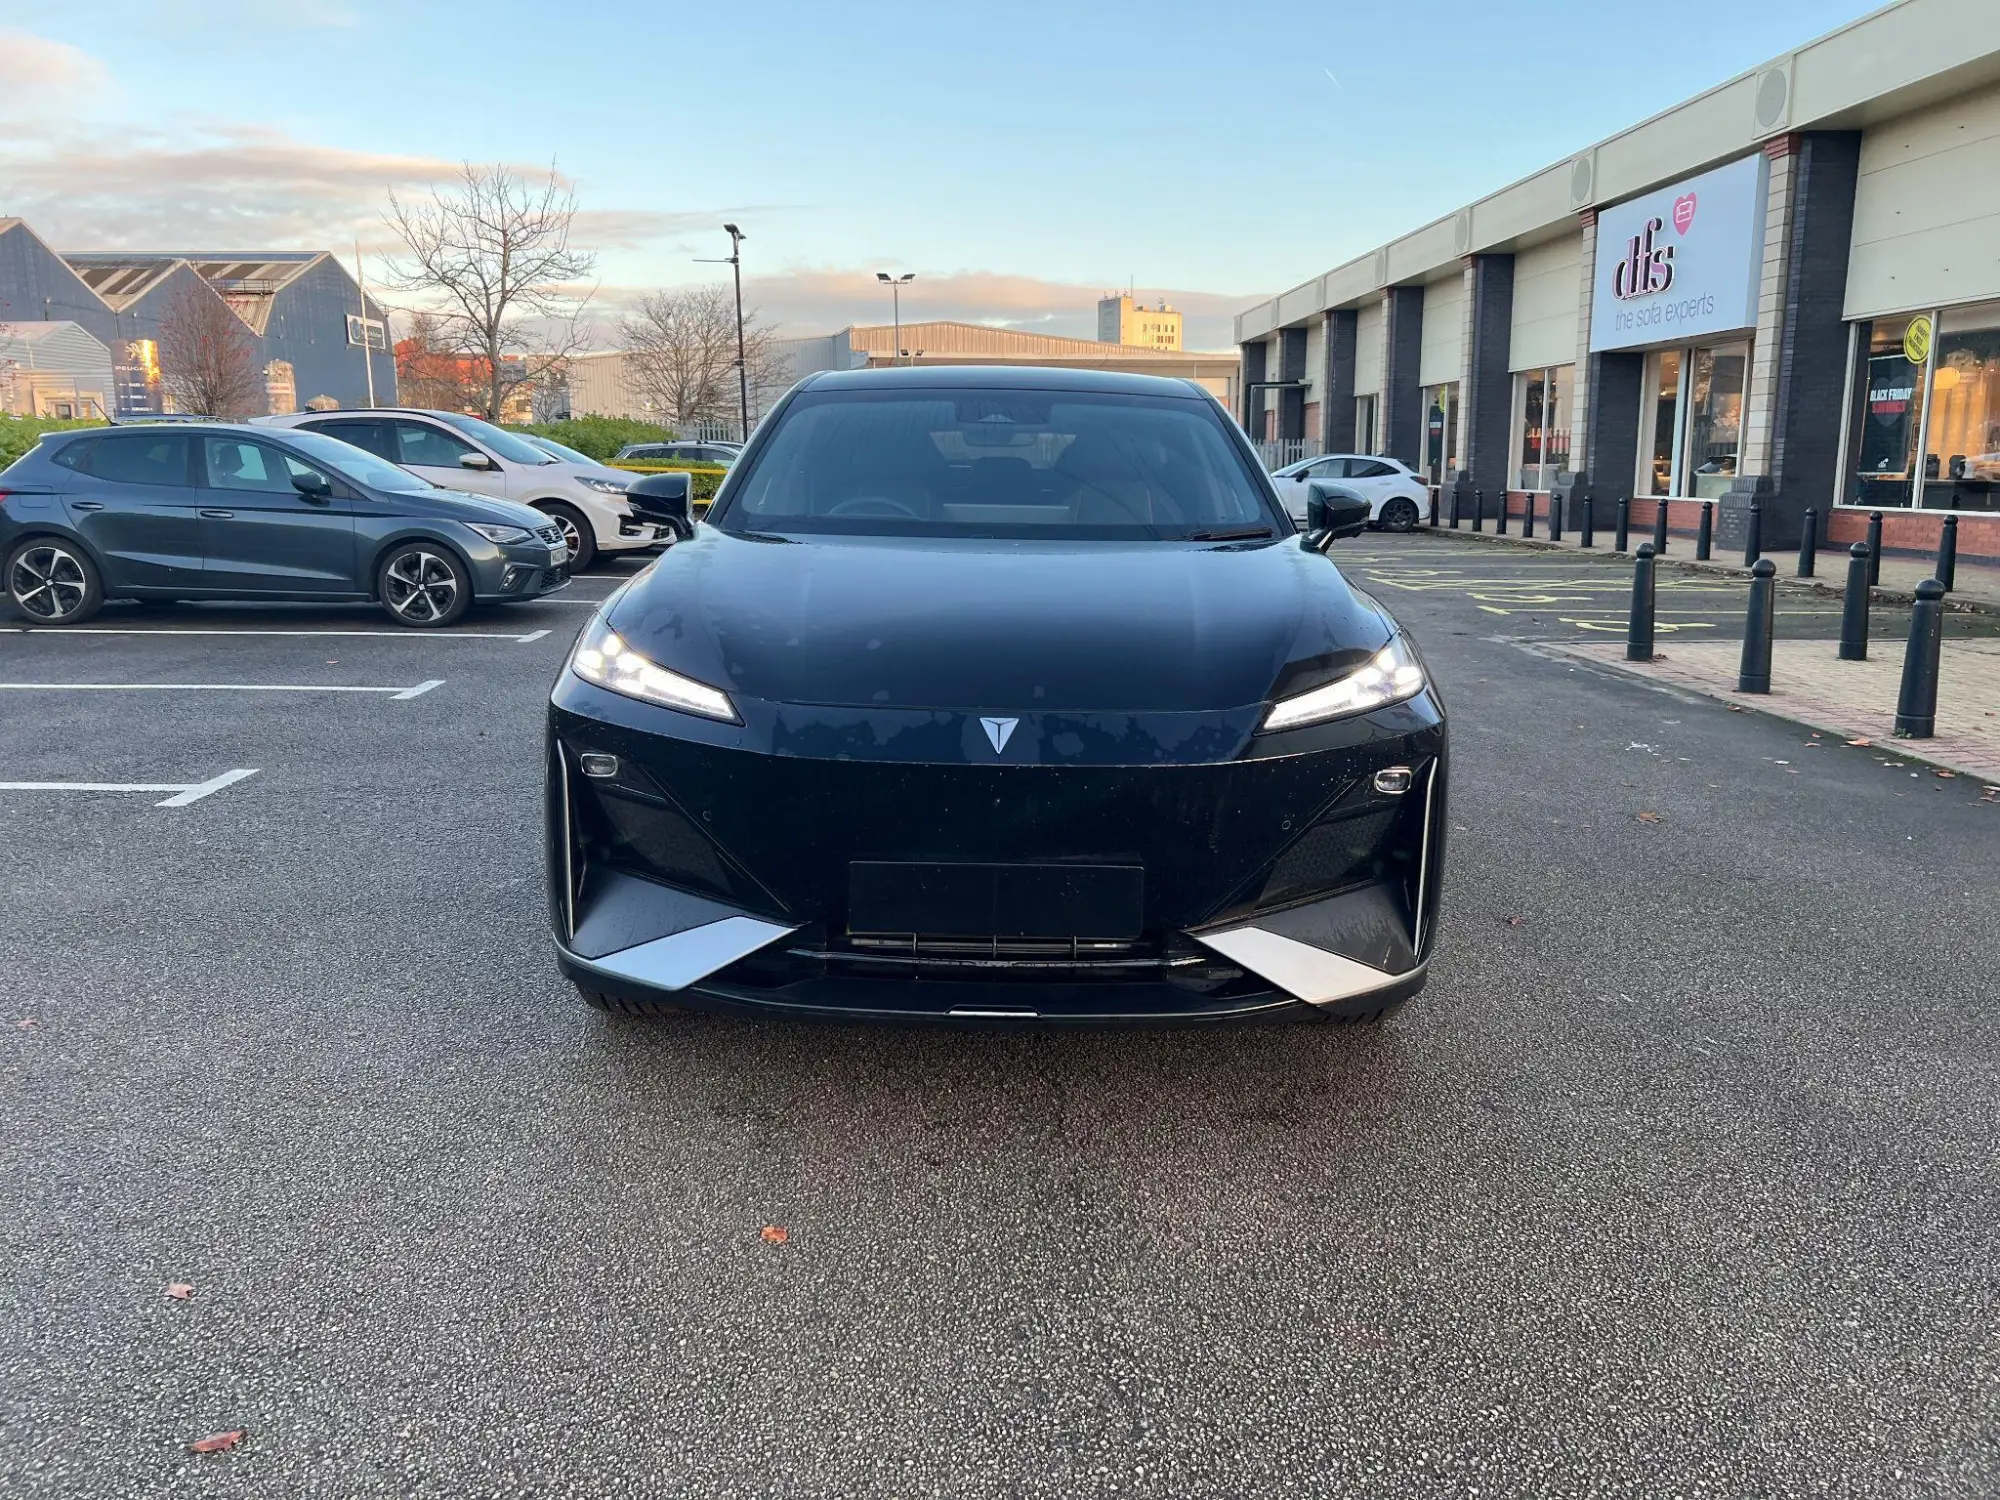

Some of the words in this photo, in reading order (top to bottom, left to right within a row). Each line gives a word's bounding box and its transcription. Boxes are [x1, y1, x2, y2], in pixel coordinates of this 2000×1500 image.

[1613, 217, 1675, 300] dfs
[1615, 309, 1633, 332] the
[1637, 302, 1662, 328] sofa
[1665, 292, 1715, 325] experts
[1870, 389, 1889, 402] BLACK
[1888, 387, 1913, 400] FRIDAY
[1526, 427, 1553, 438] BLAK
